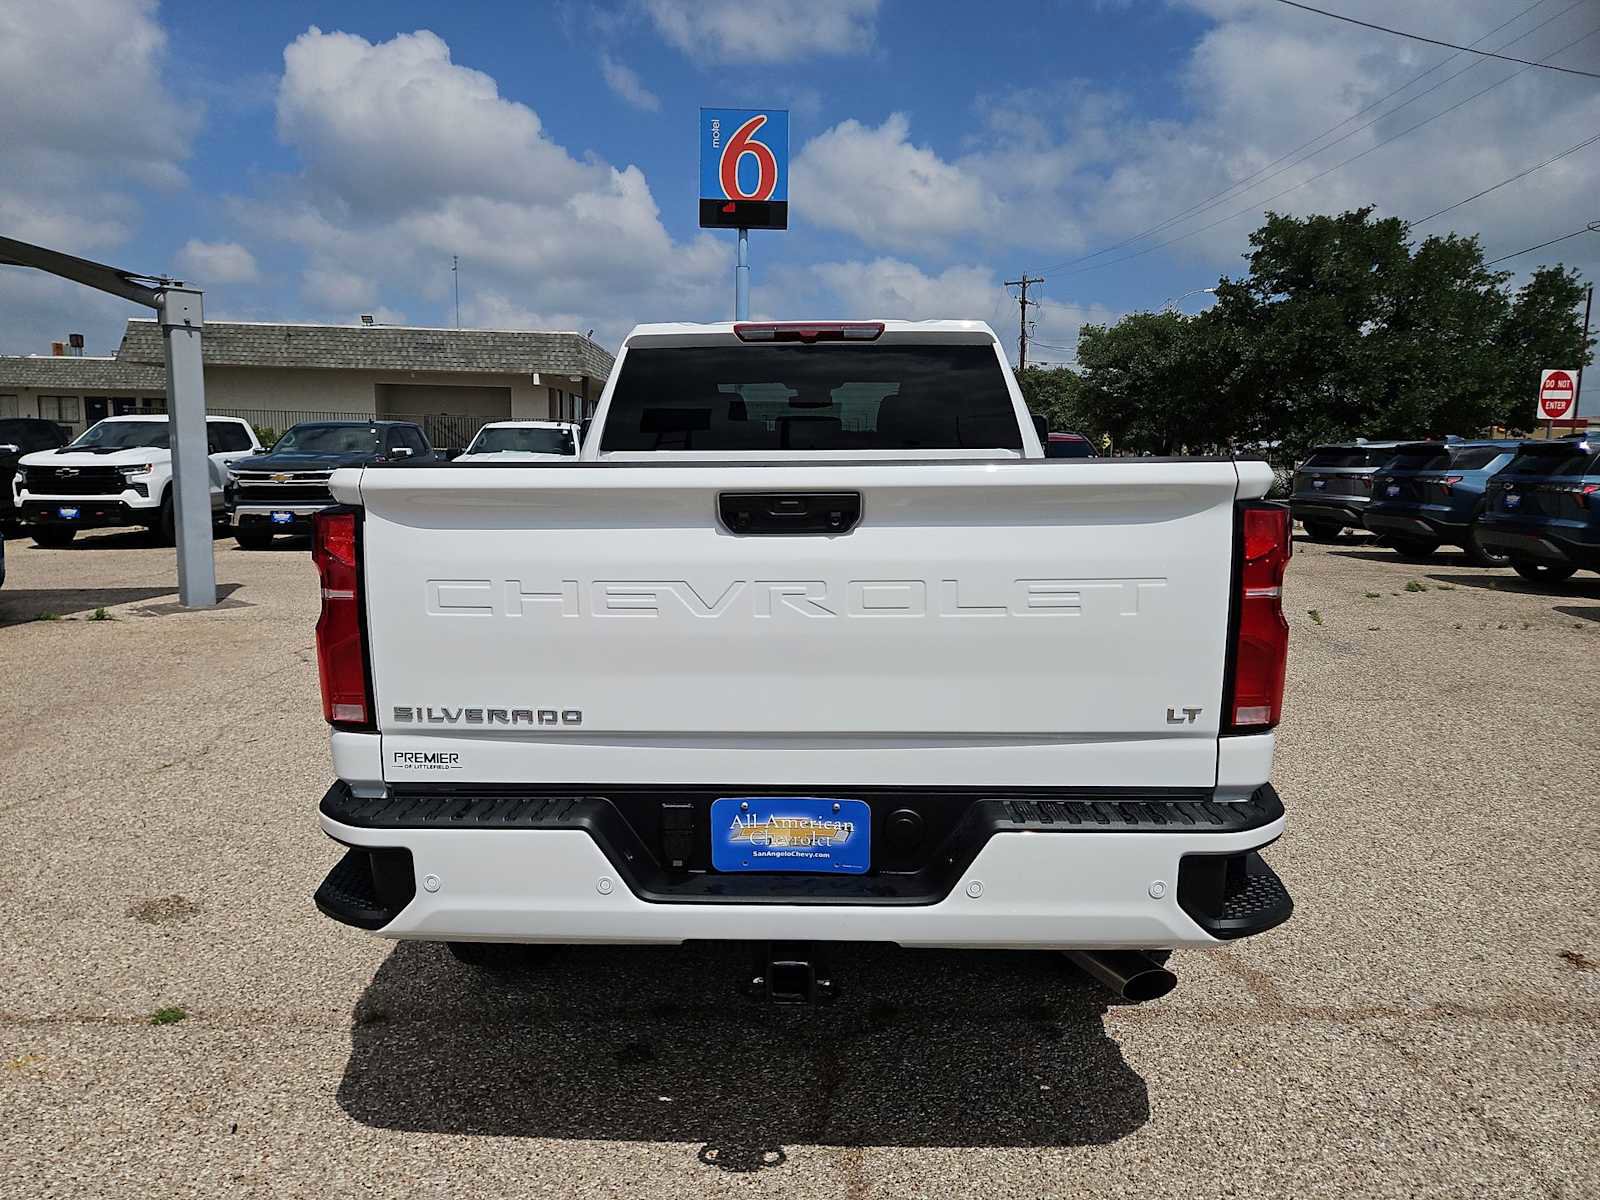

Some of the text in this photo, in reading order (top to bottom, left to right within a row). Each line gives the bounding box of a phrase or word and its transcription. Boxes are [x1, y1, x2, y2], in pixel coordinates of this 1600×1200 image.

[711, 119, 720, 148] motel
[719, 114, 778, 201] 6
[1545, 380, 1570, 388] DO NOT
[1545, 401, 1566, 410] ENTER
[425, 577, 1168, 618] CHEVROLET
[393, 706, 582, 725] SILVERADO
[1167, 708, 1203, 724] LT
[394, 752, 459, 763] PREMIER
[729, 813, 855, 832] All American
[749, 831, 833, 847] Chevrolet
[752, 850, 830, 859] SanAngeloChevy.com
